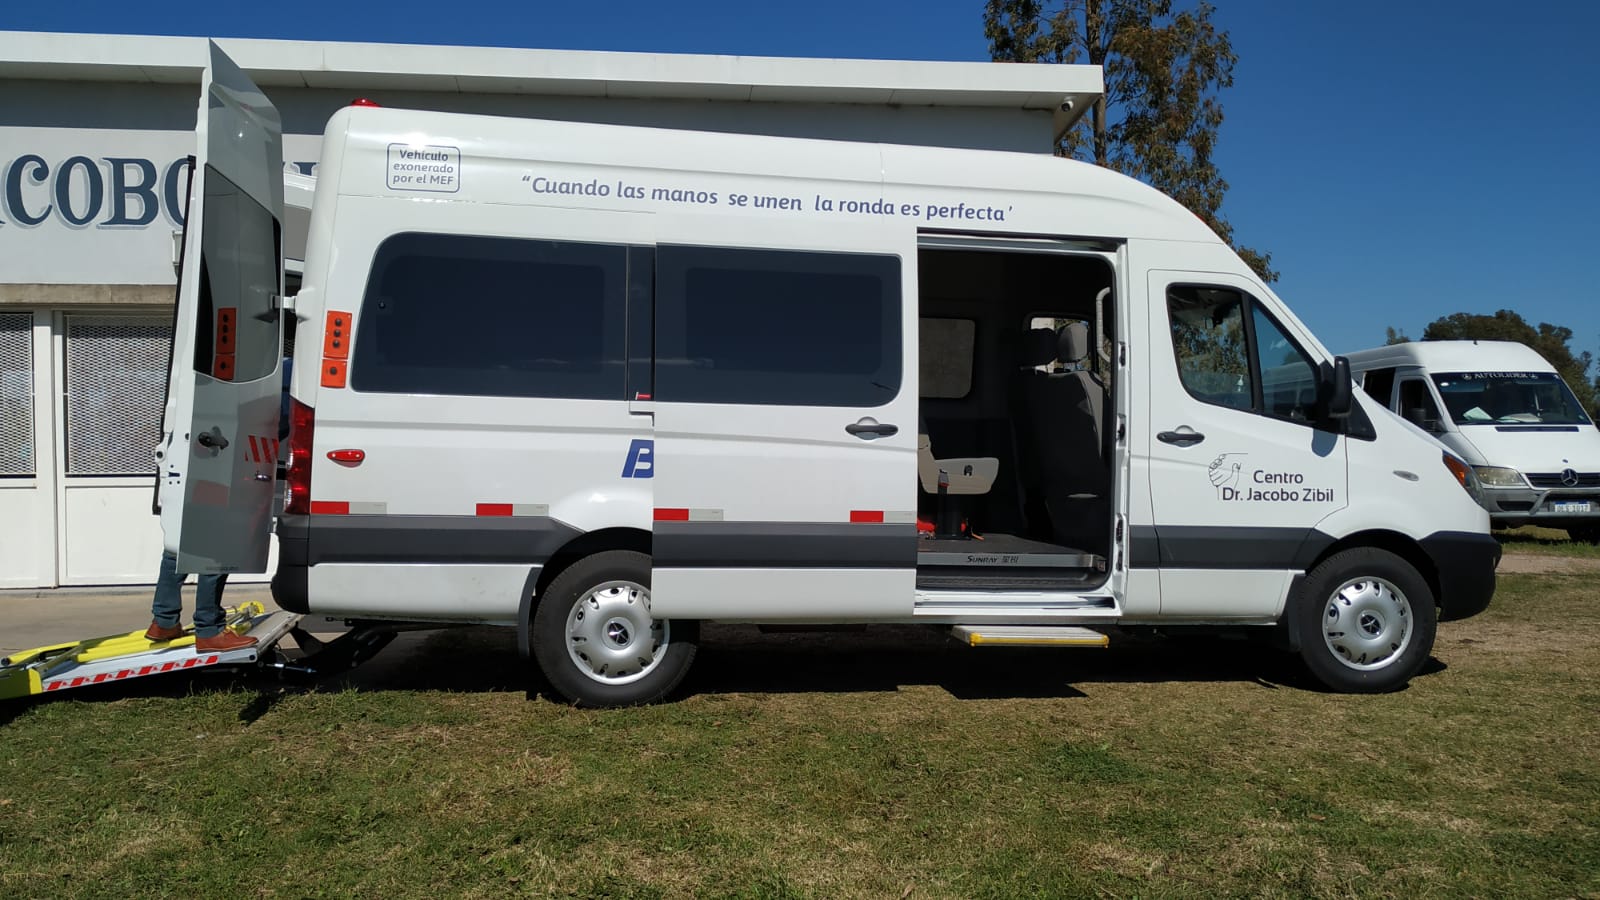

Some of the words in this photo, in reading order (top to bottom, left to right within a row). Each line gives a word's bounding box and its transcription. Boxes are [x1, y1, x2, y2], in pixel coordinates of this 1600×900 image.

[393, 163, 454, 174] exonerado
[392, 175, 413, 185] por
[416, 174, 427, 184] el
[430, 175, 454, 185] MEF
[616, 181, 645, 199] las
[651, 188, 718, 205] manos
[728, 192, 748, 207] se
[753, 194, 802, 211] unen
[814, 195, 834, 212] la
[838, 198, 895, 216] ronda
[900, 203, 921, 217] es
[1253, 470, 1304, 484] Centro
[1222, 487, 1244, 501] Dr.
[1247, 487, 1299, 502] Jacobo
[1302, 488, 1334, 502] Zibil
